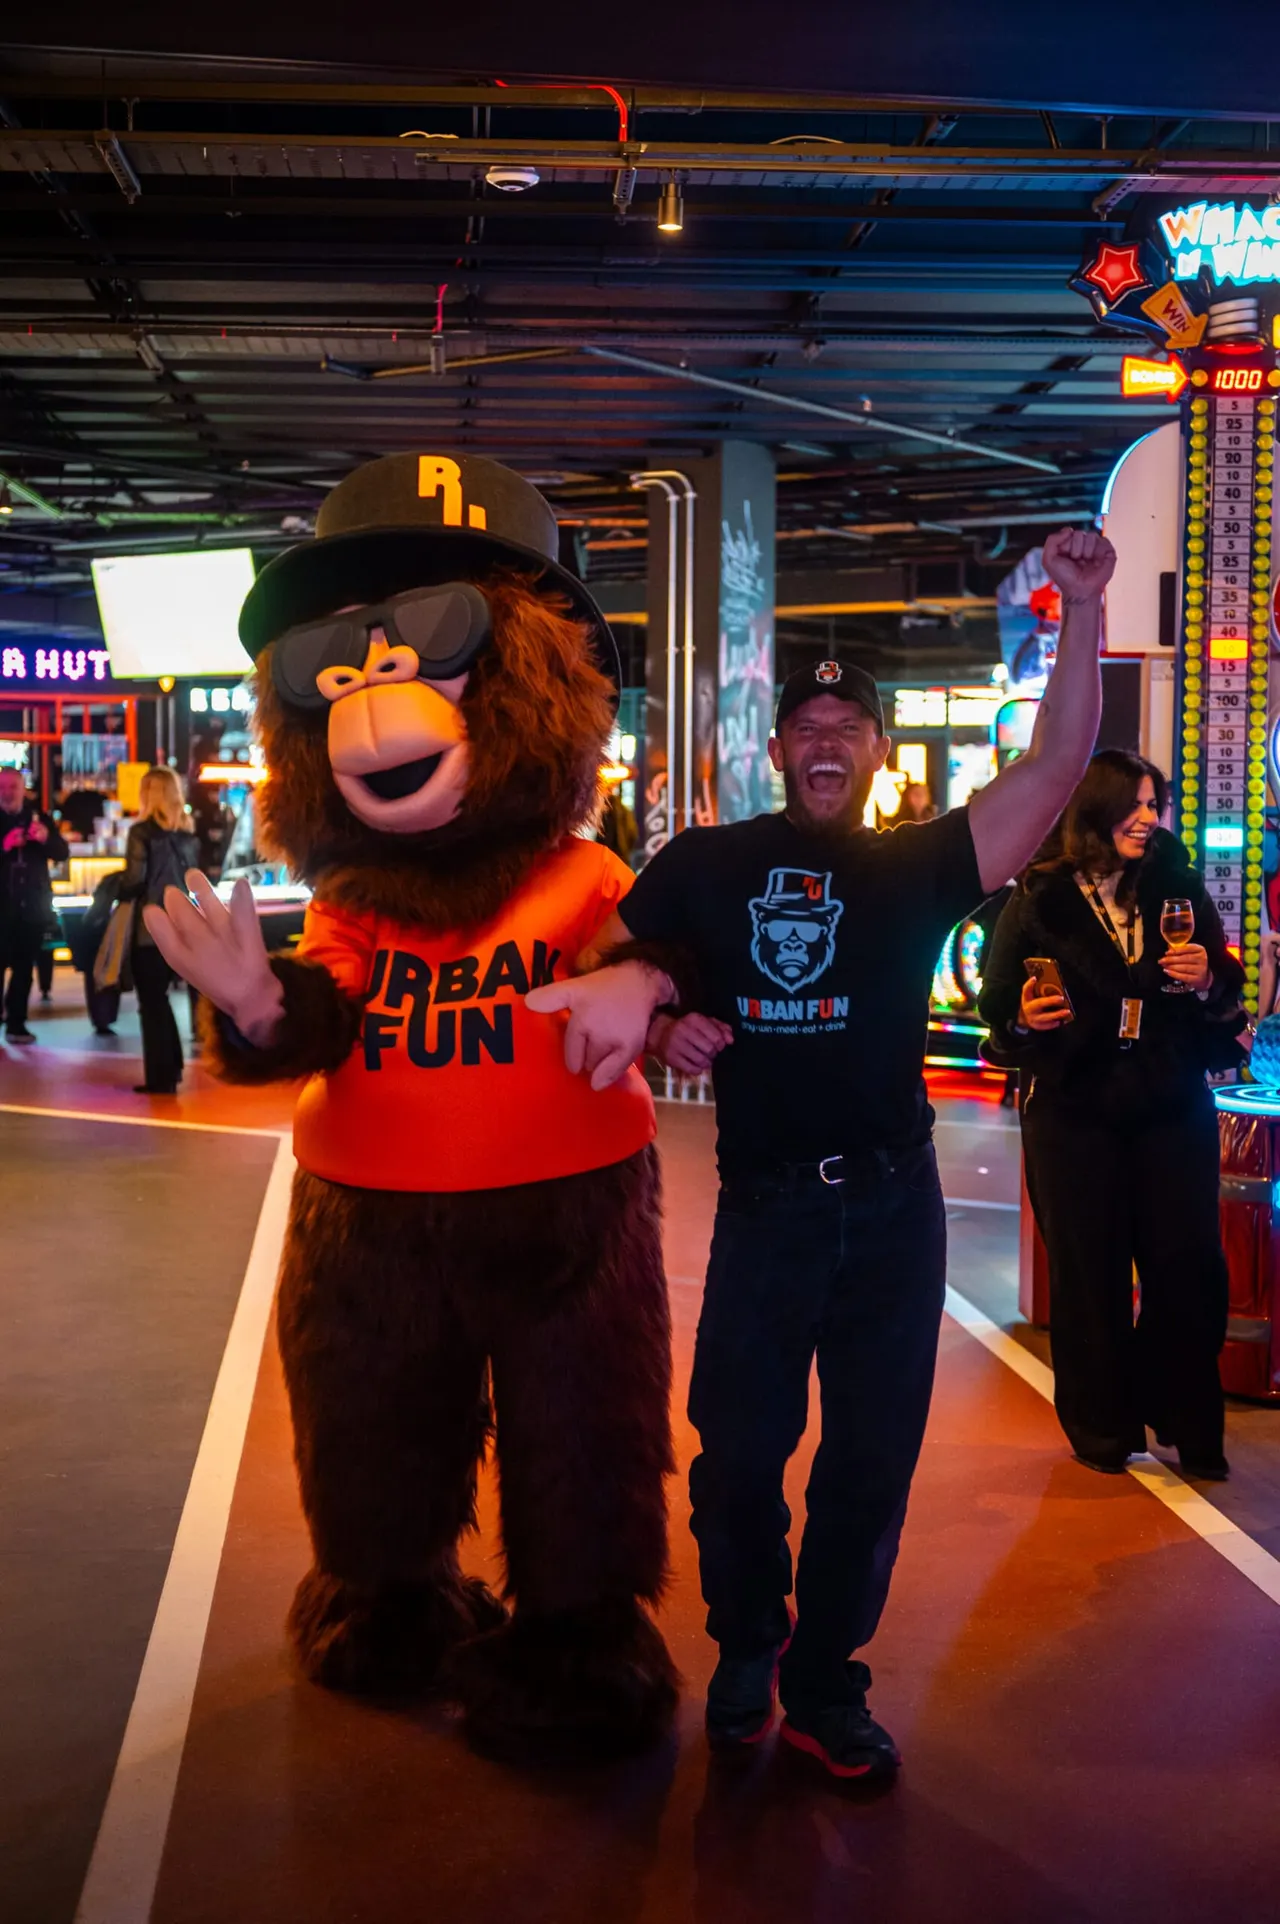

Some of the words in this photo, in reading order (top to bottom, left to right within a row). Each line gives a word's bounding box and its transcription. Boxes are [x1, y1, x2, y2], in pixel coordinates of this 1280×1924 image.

[1161, 298, 1191, 334] WIN
[1214, 369, 1263, 390] 1000
[1231, 401, 1239, 411] 5
[1225, 418, 1243, 430] 25
[1228, 436, 1240, 446] 10
[1225, 453, 1242, 464] 20
[1227, 471, 1240, 480] 10
[1224, 487, 1241, 499] 40
[1229, 506, 1236, 516] 5
[1223, 522, 1241, 534] 50
[1228, 540, 1235, 550] 5
[1222, 556, 1239, 568] 25
[1224, 575, 1237, 584] 10
[1221, 592, 1238, 602] 35
[1220, 626, 1238, 637] 40
[35, 648, 111, 680] HUT
[1220, 662, 1236, 672] 15
[1224, 678, 1232, 688] 5
[1216, 694, 1239, 706] 100
[1224, 713, 1230, 723] 5
[1218, 729, 1235, 740] 30
[1219, 748, 1232, 757] 10
[1217, 764, 1234, 775] 25
[1218, 782, 1232, 792] 10
[1216, 798, 1234, 810] 50
[1214, 866, 1232, 878] 20
[1220, 884, 1226, 894] 5
[1217, 900, 1234, 912] 00
[736, 996, 803, 1021] URBAN
[807, 996, 849, 1021] FUN
[364, 1003, 515, 1071] FUN
